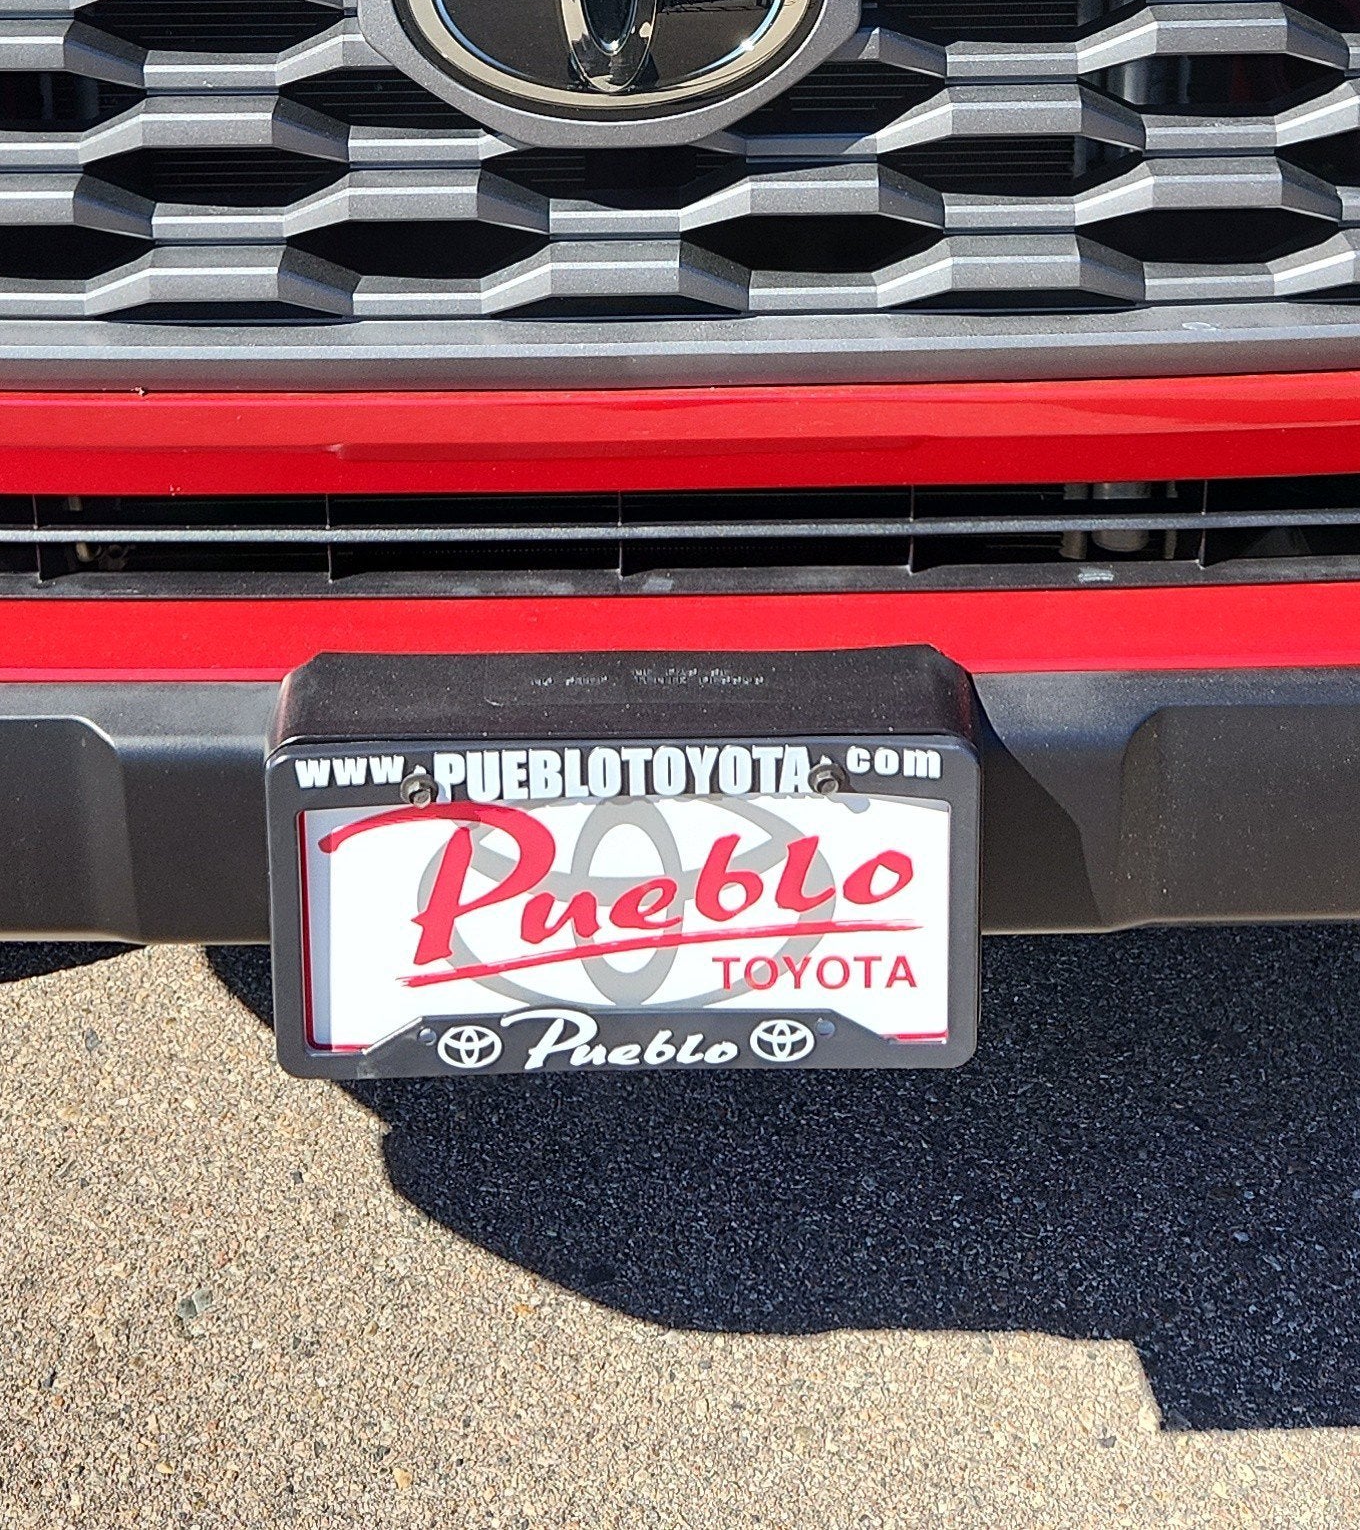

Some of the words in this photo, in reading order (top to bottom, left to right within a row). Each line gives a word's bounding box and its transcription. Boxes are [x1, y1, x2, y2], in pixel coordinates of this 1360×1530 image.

[318, 801, 915, 965] Pueblo
[712, 955, 918, 991] TOYOTA
[501, 1007, 739, 1071] Pueblo
